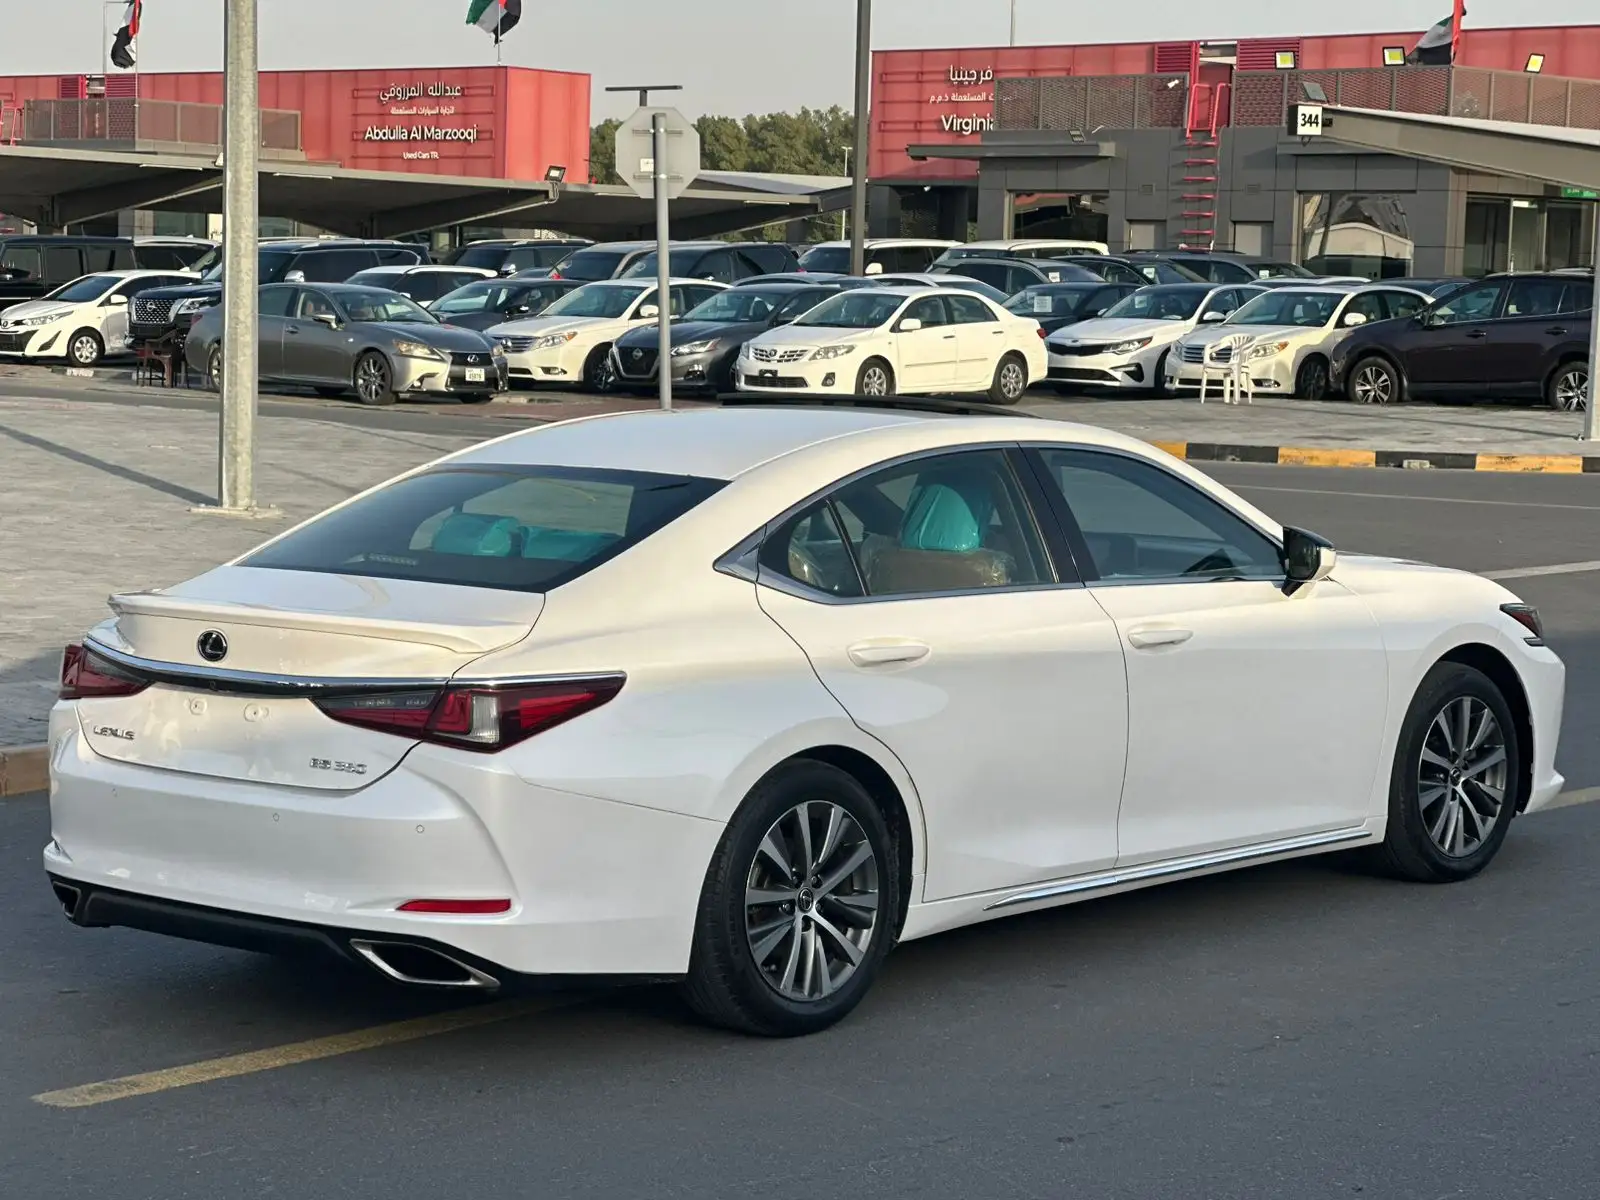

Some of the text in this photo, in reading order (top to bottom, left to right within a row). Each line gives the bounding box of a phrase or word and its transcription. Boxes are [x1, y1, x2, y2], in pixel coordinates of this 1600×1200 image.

[949, 64, 993, 85] فرجينيا
[379, 81, 462, 104] عبدالله المرزوقي
[1300, 113, 1319, 127] 344
[364, 123, 478, 144] Abdulla Al Marzooqi
[402, 151, 418, 160] Used
[417, 151, 430, 159] Cars
[93, 725, 135, 740] LEXUS
[310, 757, 368, 775] ES 350
